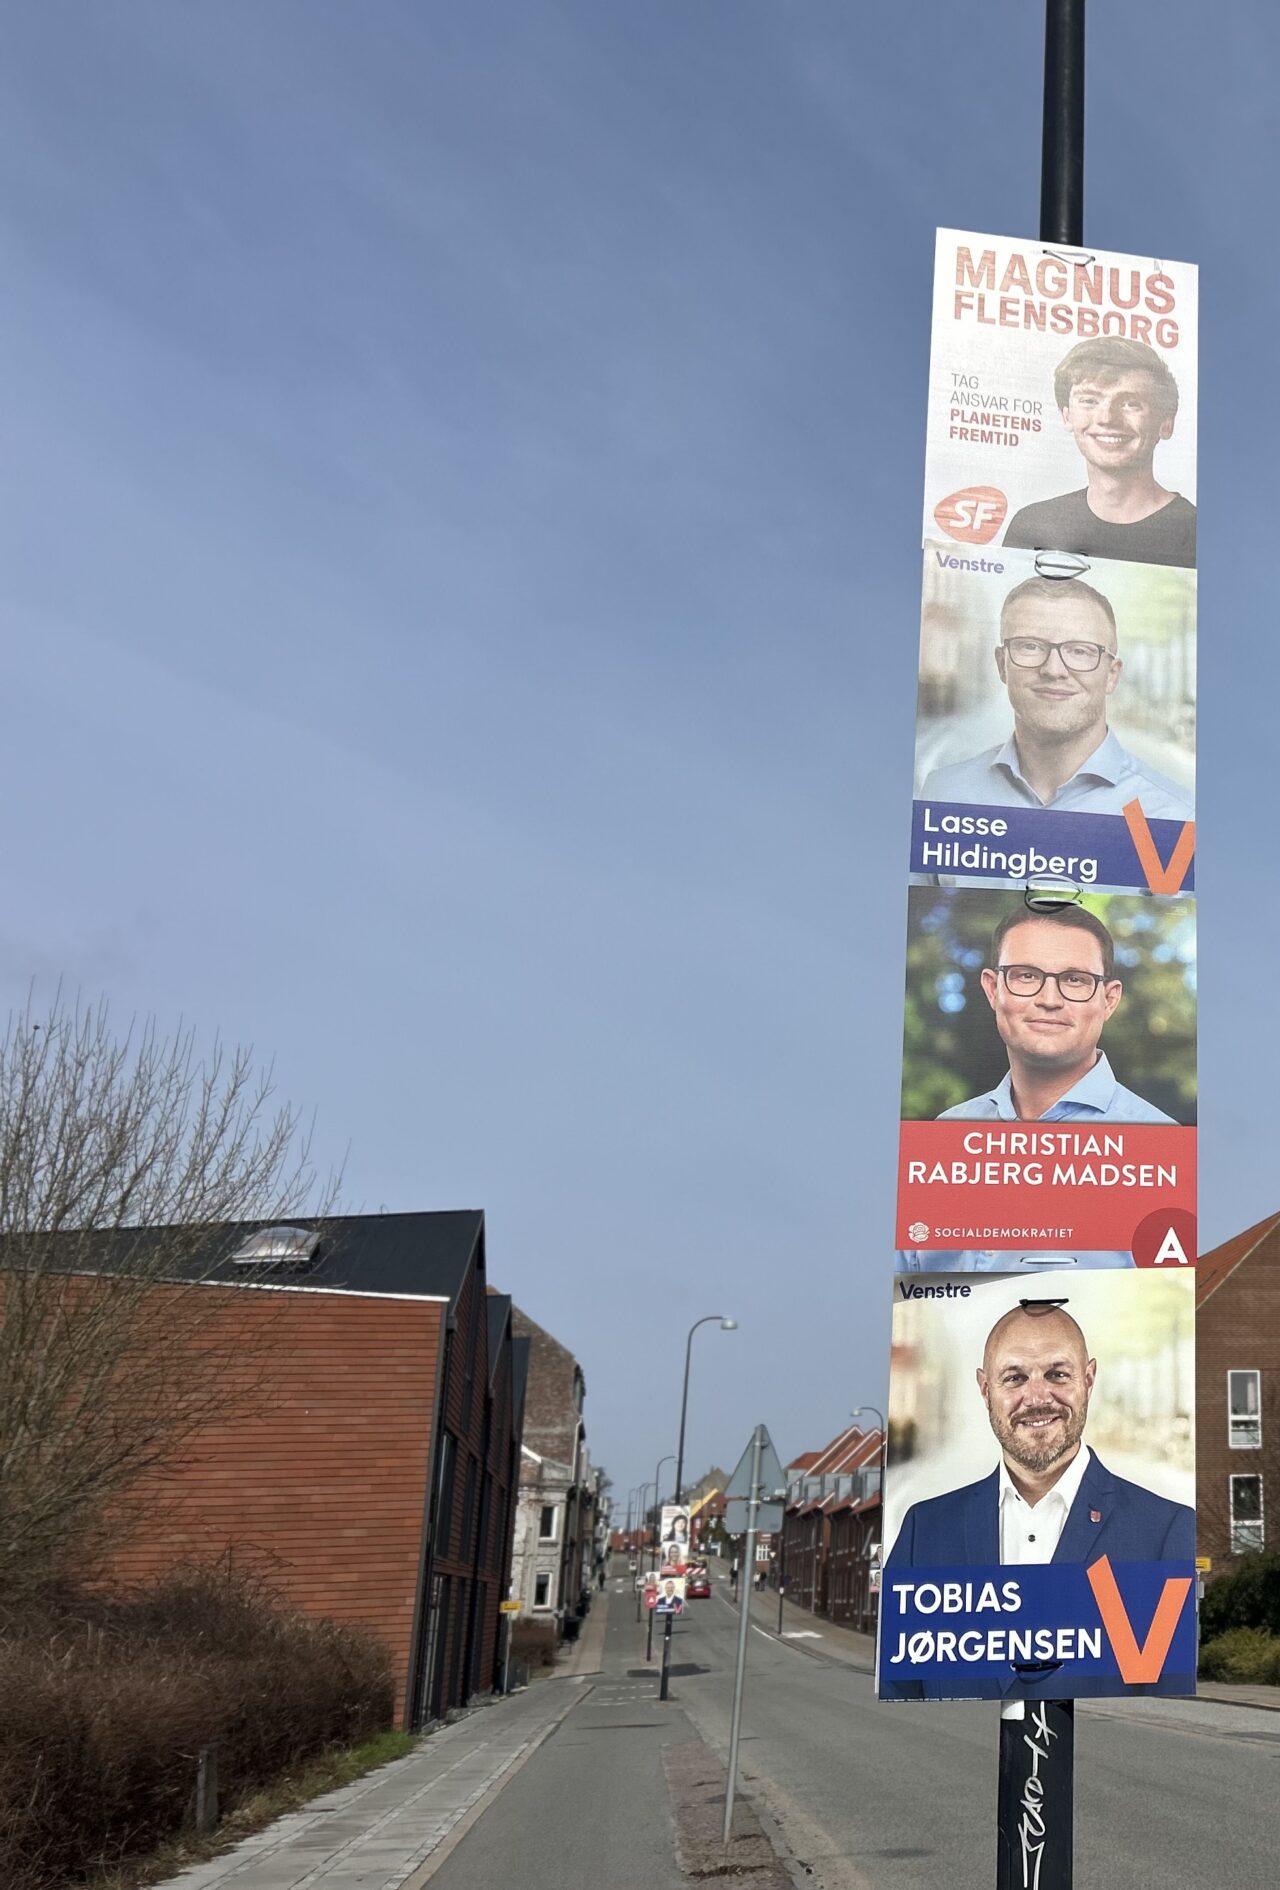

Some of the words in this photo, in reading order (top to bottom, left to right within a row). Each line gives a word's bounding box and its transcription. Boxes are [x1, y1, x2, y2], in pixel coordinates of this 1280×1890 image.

[955, 246, 1176, 315] MAGNUS
[953, 290, 1180, 349] FLENSBORG
[951, 373, 979, 389] TAG
[950, 390, 1008, 411] ANSVAR
[1013, 398, 1042, 415] FOR
[950, 408, 1042, 432] PLANETENS
[949, 425, 1019, 447] FREMTID
[949, 499, 997, 531] SF
[936, 551, 1004, 574] Venstre
[924, 808, 1008, 836] Lasse
[922, 842, 1098, 883] Hildingberg
[963, 1132, 1124, 1157] CHRISTIAN
[908, 1161, 1043, 1186] RABJERG
[1052, 1163, 1177, 1187] MADSEN
[934, 1227, 1074, 1239] SOCIALDEMOKRATIET
[1153, 1226, 1190, 1264] A
[900, 1281, 972, 1300] Venstre
[892, 1581, 1022, 1615] TOBIAS
[890, 1628, 1101, 1665] JØRGENSEN
